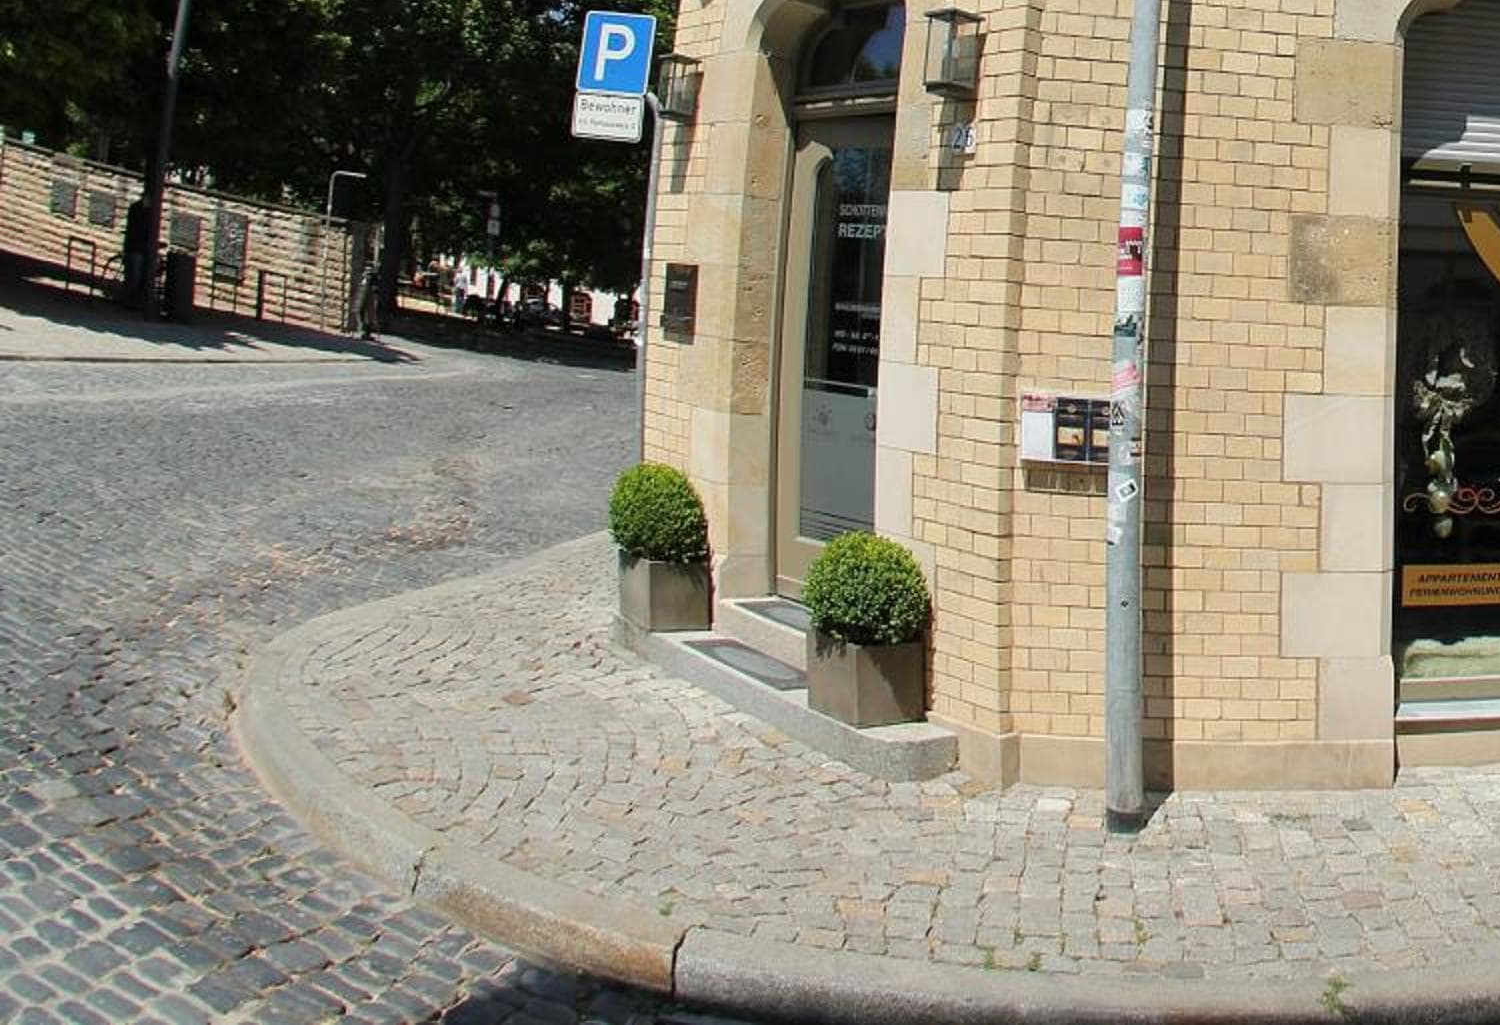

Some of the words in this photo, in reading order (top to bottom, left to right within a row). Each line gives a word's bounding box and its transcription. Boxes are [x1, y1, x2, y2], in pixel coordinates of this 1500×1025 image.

[594, 23, 635, 81] P
[580, 98, 637, 115] Bewohner
[953, 127, 974, 149] 26
